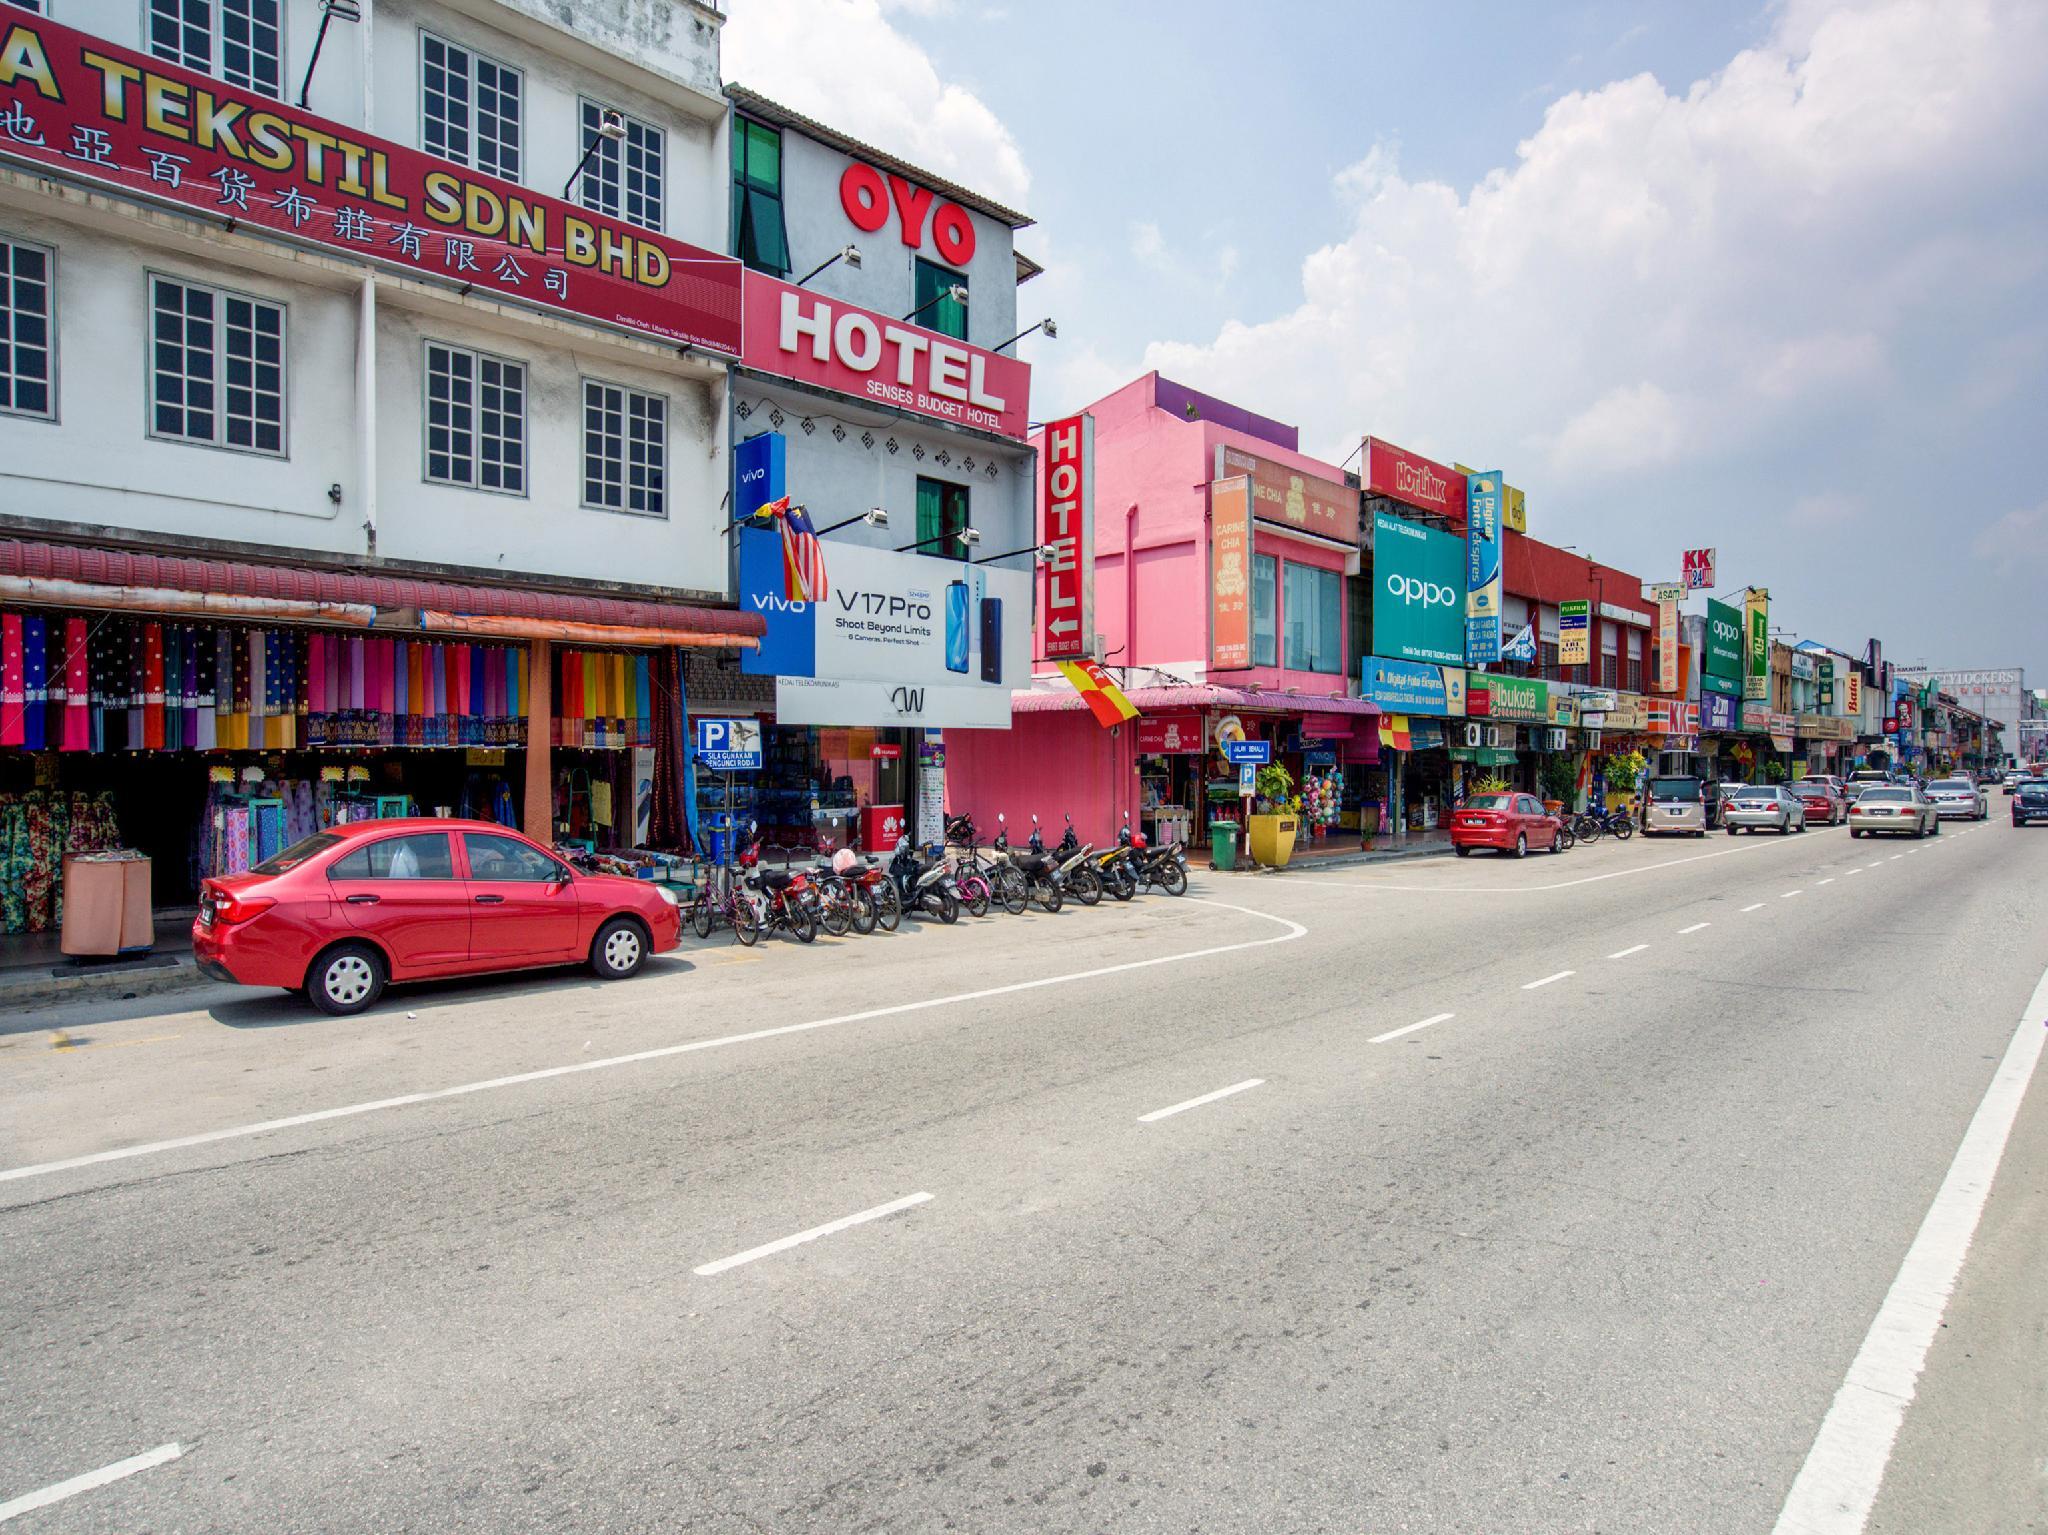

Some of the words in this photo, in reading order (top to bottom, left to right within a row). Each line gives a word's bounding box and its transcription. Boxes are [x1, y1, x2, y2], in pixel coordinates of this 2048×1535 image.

[81, 47, 408, 213] TEKSTIL
[424, 170, 546, 255] SDN
[564, 214, 671, 288] BHD
[839, 162, 976, 267] OYO
[779, 290, 1005, 413] HOTEL
[866, 379, 914, 405] SENSES
[917, 393, 964, 418] BUDGET
[967, 408, 1001, 429] HOTEL
[741, 466, 765, 484] vivo
[1267, 487, 1282, 503] CHIA
[1050, 425, 1078, 609] HOTEL
[1472, 499, 1481, 528] Foto
[1216, 521, 1245, 537] CARINE
[1221, 537, 1240, 550] CHIA
[1684, 549, 1711, 569] KK
[1692, 569, 1702, 586] 24
[1387, 573, 1456, 608] oppo
[751, 591, 806, 614] vivo
[836, 617, 865, 630] Shoot
[867, 621, 902, 634] Beyond
[904, 624, 931, 637] Limits
[883, 637, 905, 645] Perfect
[1387, 672, 1406, 688] Digital
[1848, 677, 1858, 713] Bata
[1670, 702, 1688, 733] KK
[706, 723, 725, 749] P
[737, 759, 754, 767] RODA
[1244, 768, 1252, 782] P
